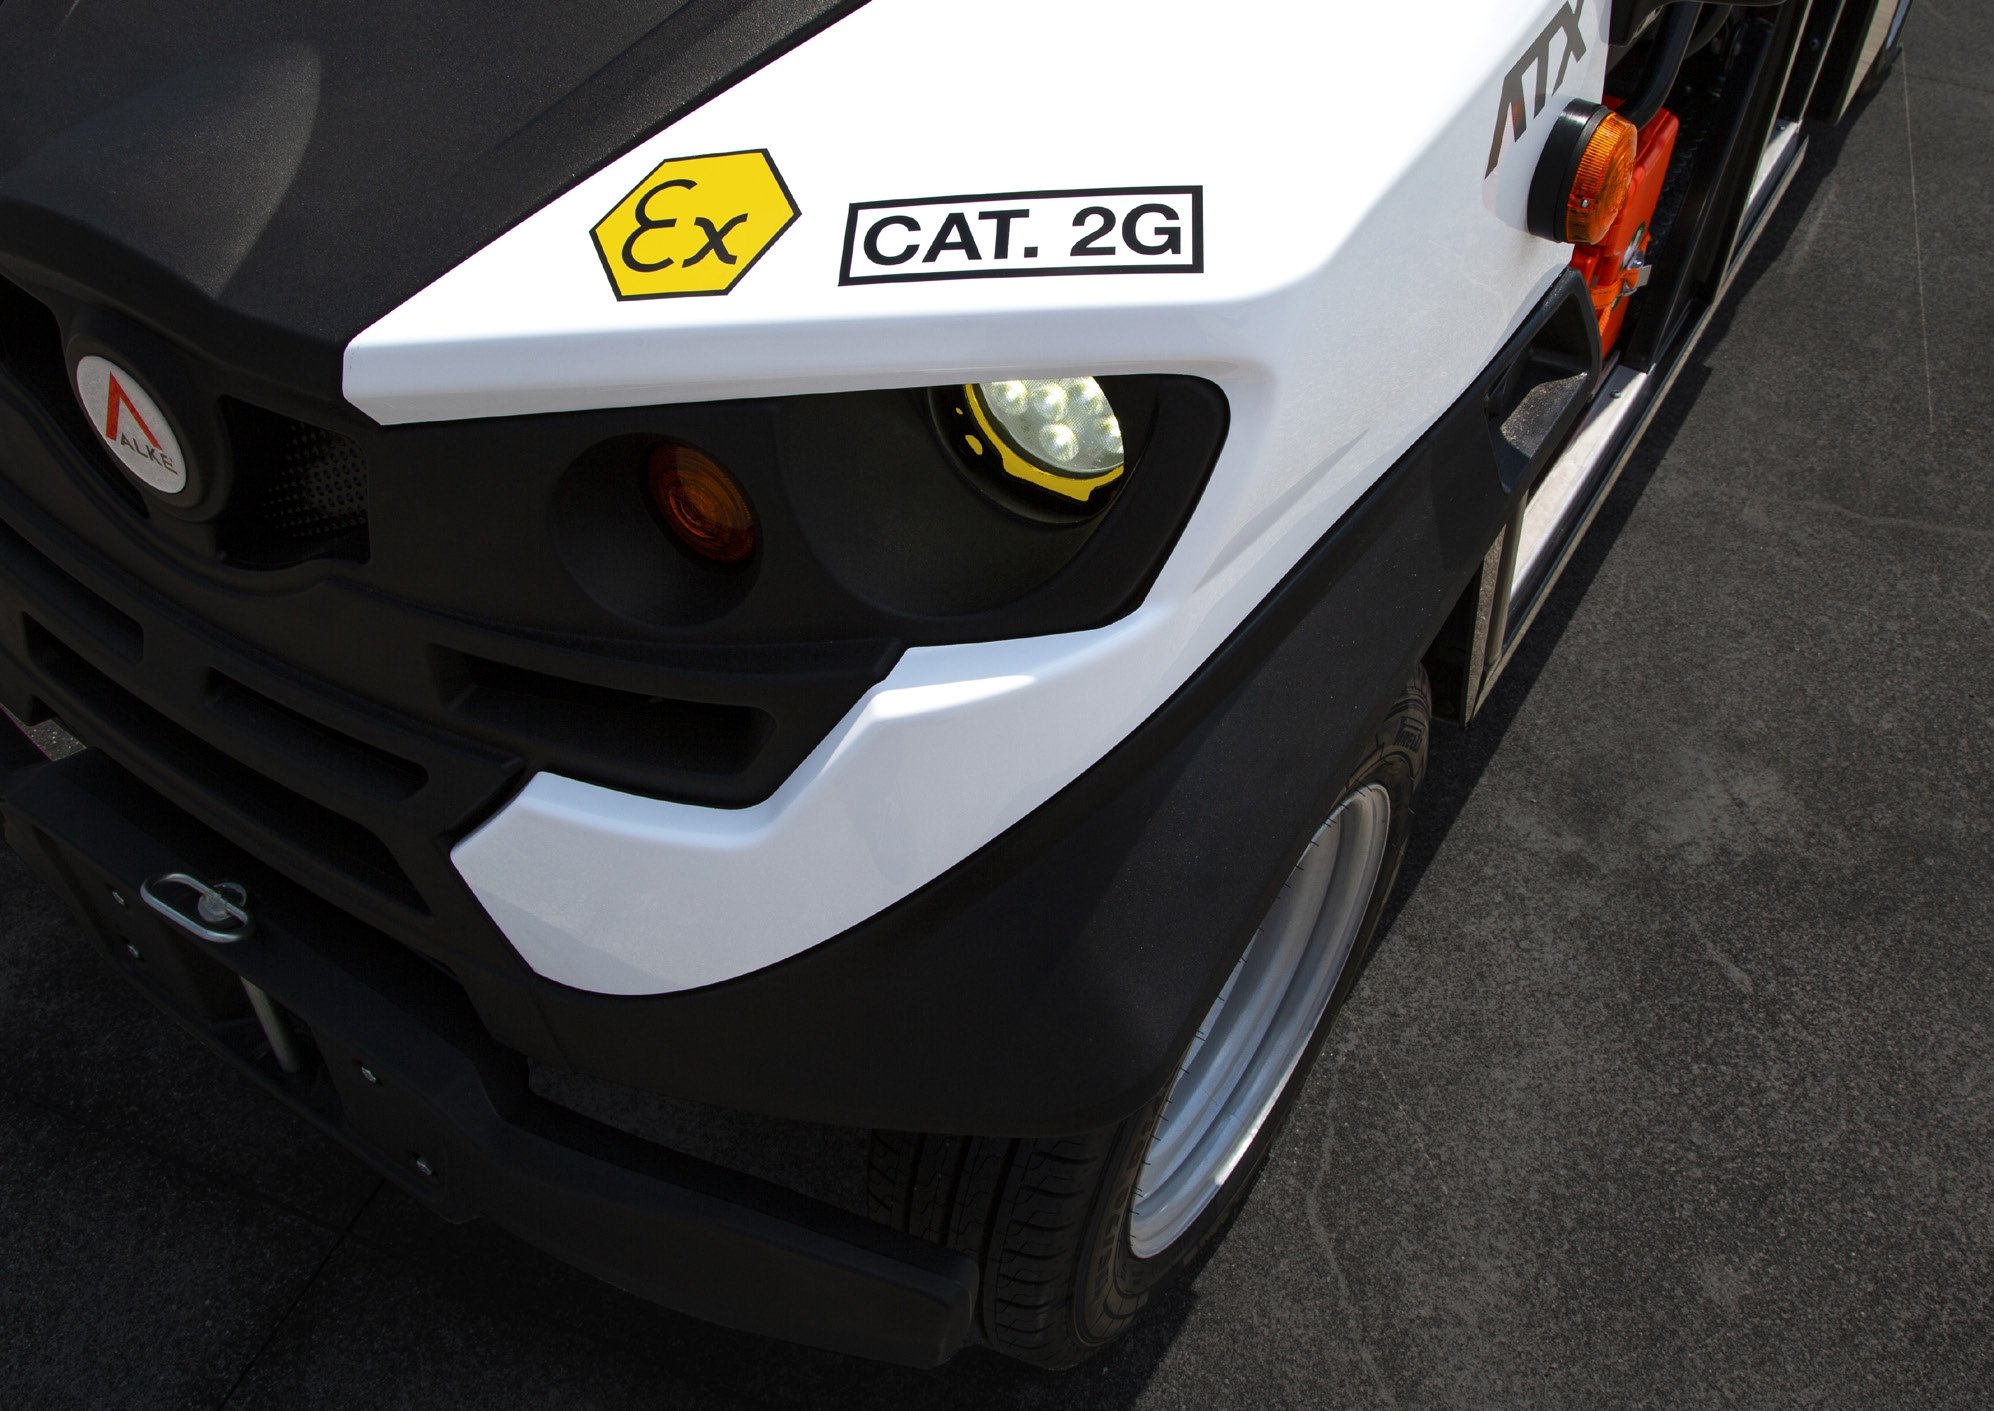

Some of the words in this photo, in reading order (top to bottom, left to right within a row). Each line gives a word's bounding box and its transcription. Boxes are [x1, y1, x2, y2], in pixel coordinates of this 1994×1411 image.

[621, 178, 749, 273] Ex
[863, 208, 1039, 266] CAT.
[1070, 203, 1182, 257] 2G
